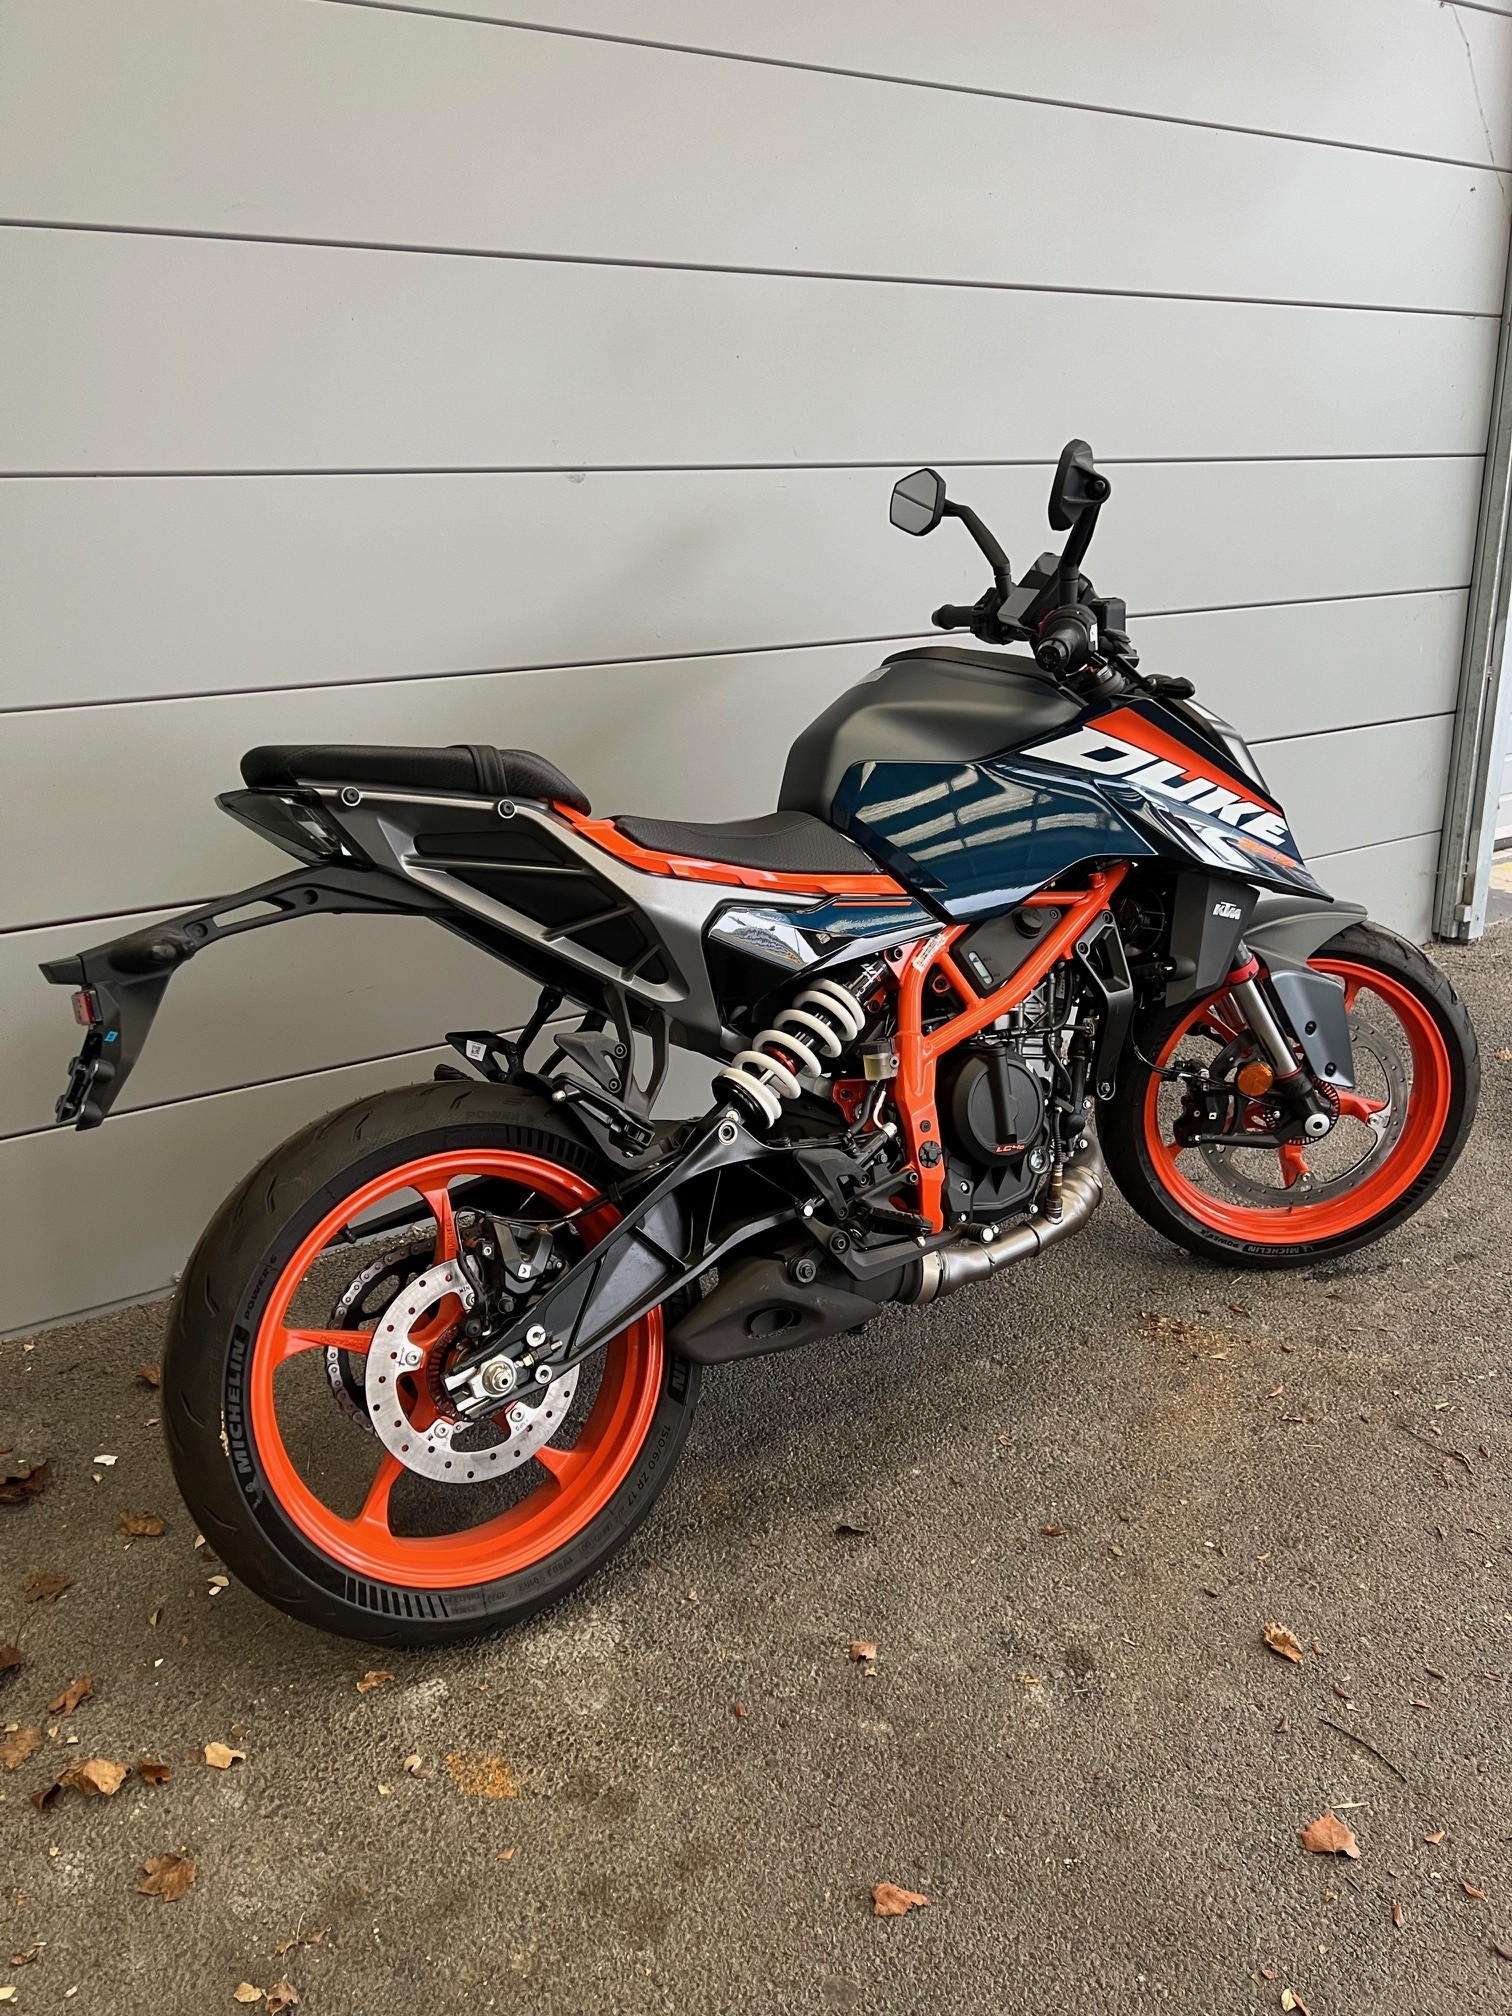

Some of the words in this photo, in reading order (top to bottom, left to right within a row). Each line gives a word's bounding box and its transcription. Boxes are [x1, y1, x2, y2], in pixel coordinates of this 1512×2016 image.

[1020, 725, 1288, 846] DUKE
[1212, 901, 1242, 920] KTM
[1206, 1233, 1239, 1248] POWER
[1247, 1245, 1301, 1255] MICHELIN
[244, 1270, 271, 1321] POWER
[269, 1254, 278, 1264] 6
[228, 1339, 252, 1475] MICHELIN
[648, 1425, 671, 1470] 150/60
[636, 1471, 650, 1491] ZR
[628, 1491, 638, 1506] 17
